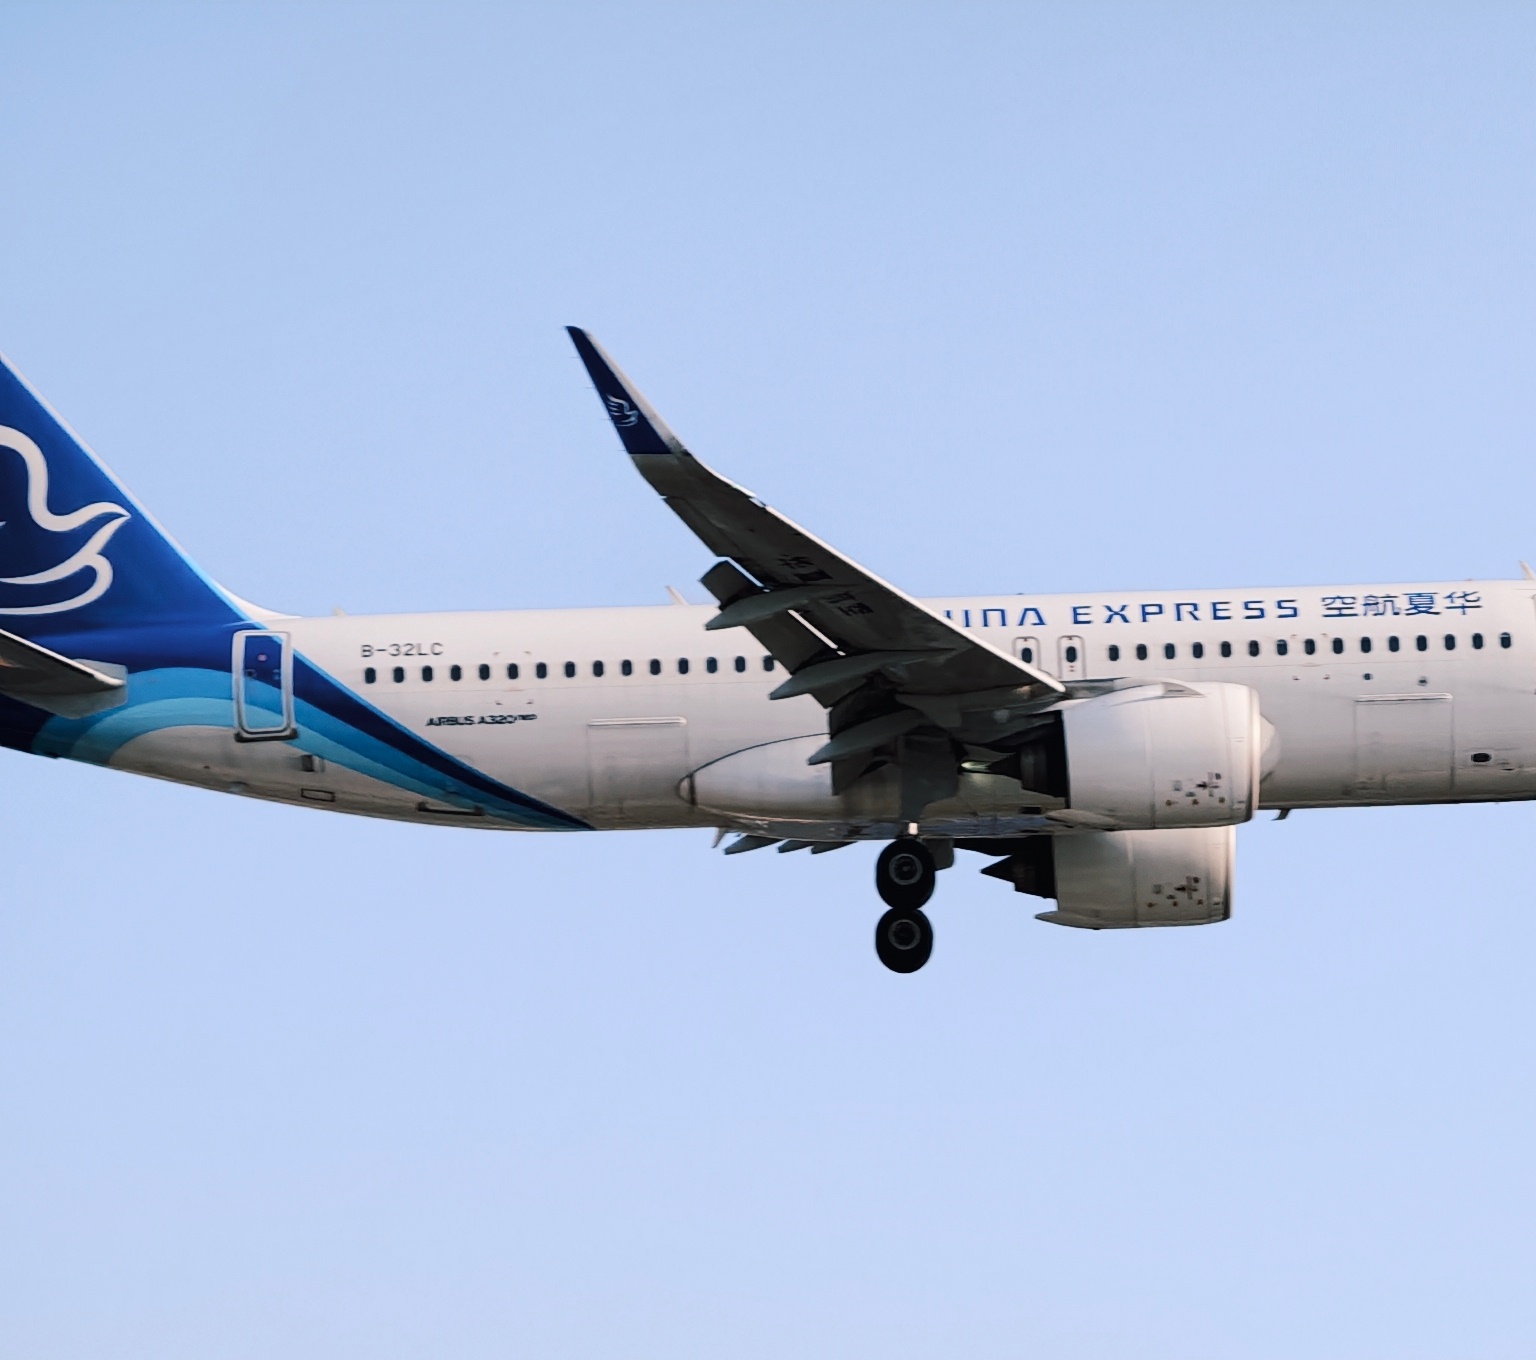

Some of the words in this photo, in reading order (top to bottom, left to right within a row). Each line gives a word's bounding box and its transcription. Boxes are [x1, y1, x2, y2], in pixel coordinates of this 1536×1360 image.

[1072, 599, 1298, 625] EXPRESS
[1320, 591, 1483, 618] 空航夏华
[360, 642, 444, 658] B-32LC
